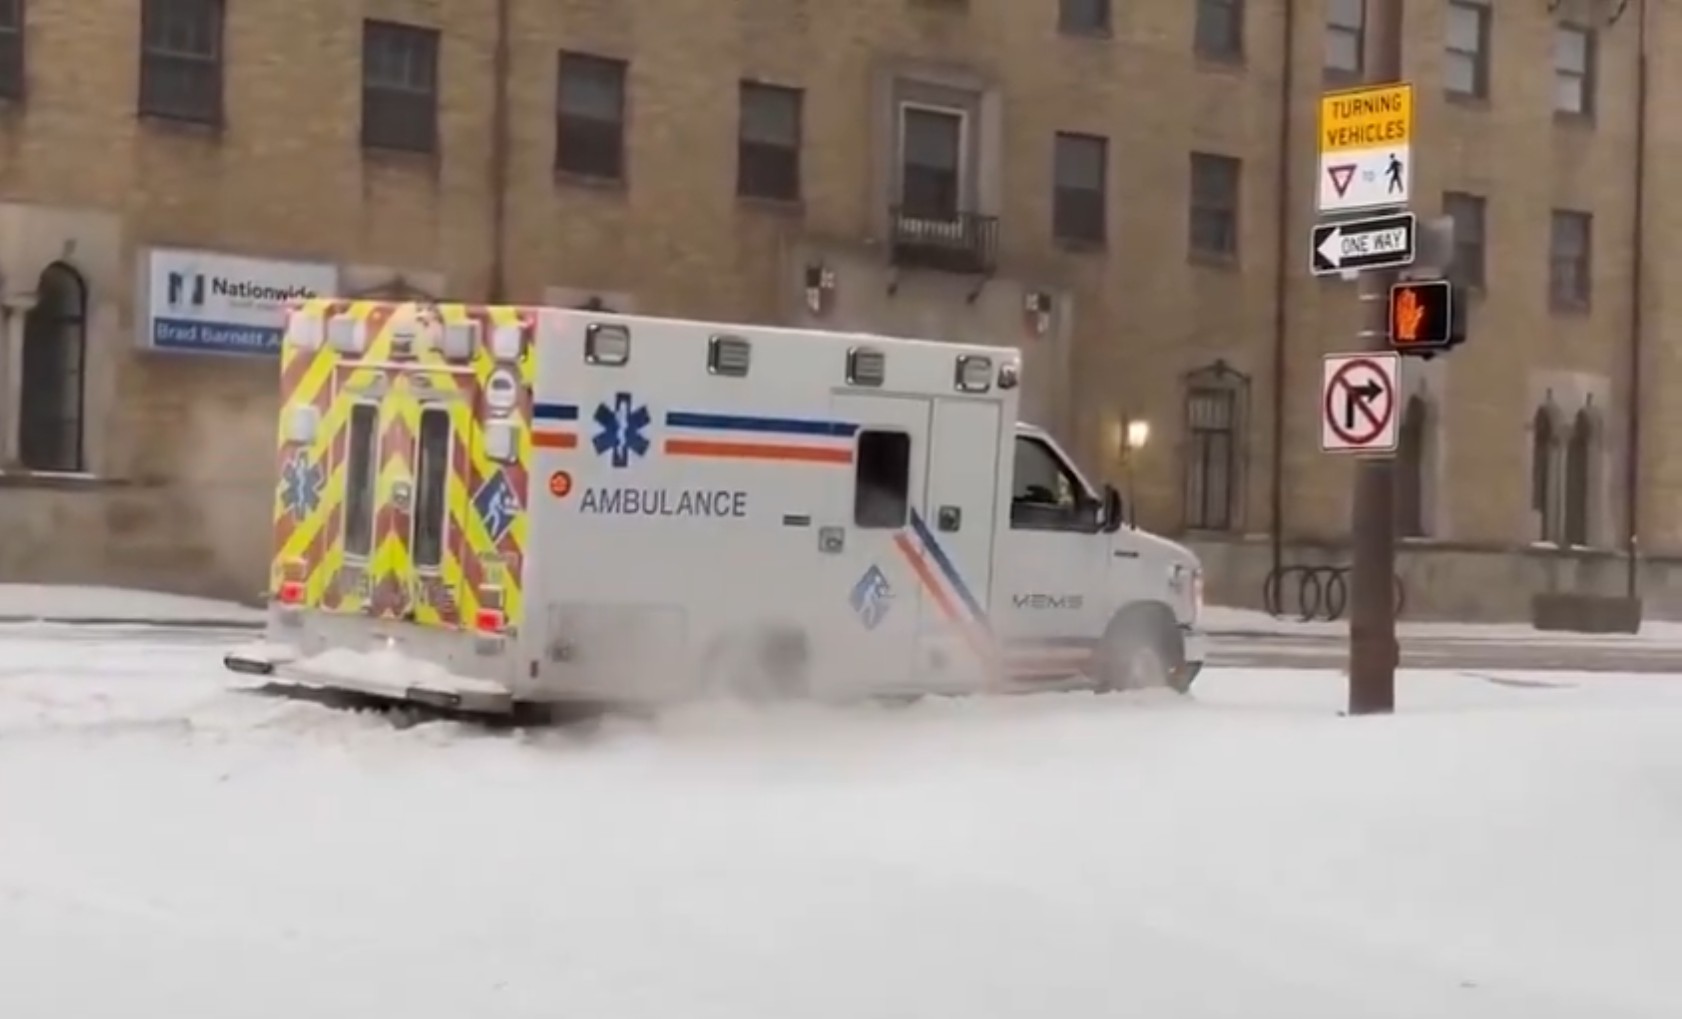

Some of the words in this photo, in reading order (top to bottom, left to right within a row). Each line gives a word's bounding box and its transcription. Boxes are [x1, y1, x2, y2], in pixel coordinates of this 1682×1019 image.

[1332, 93, 1402, 119] TURNING
[1327, 120, 1405, 146] VEHICLES
[1341, 234, 1369, 255] ONE
[1374, 230, 1403, 250] WAY
[157, 323, 197, 342] Brad
[200, 327, 263, 347] Barnett
[580, 487, 748, 517] AMBULANCE
